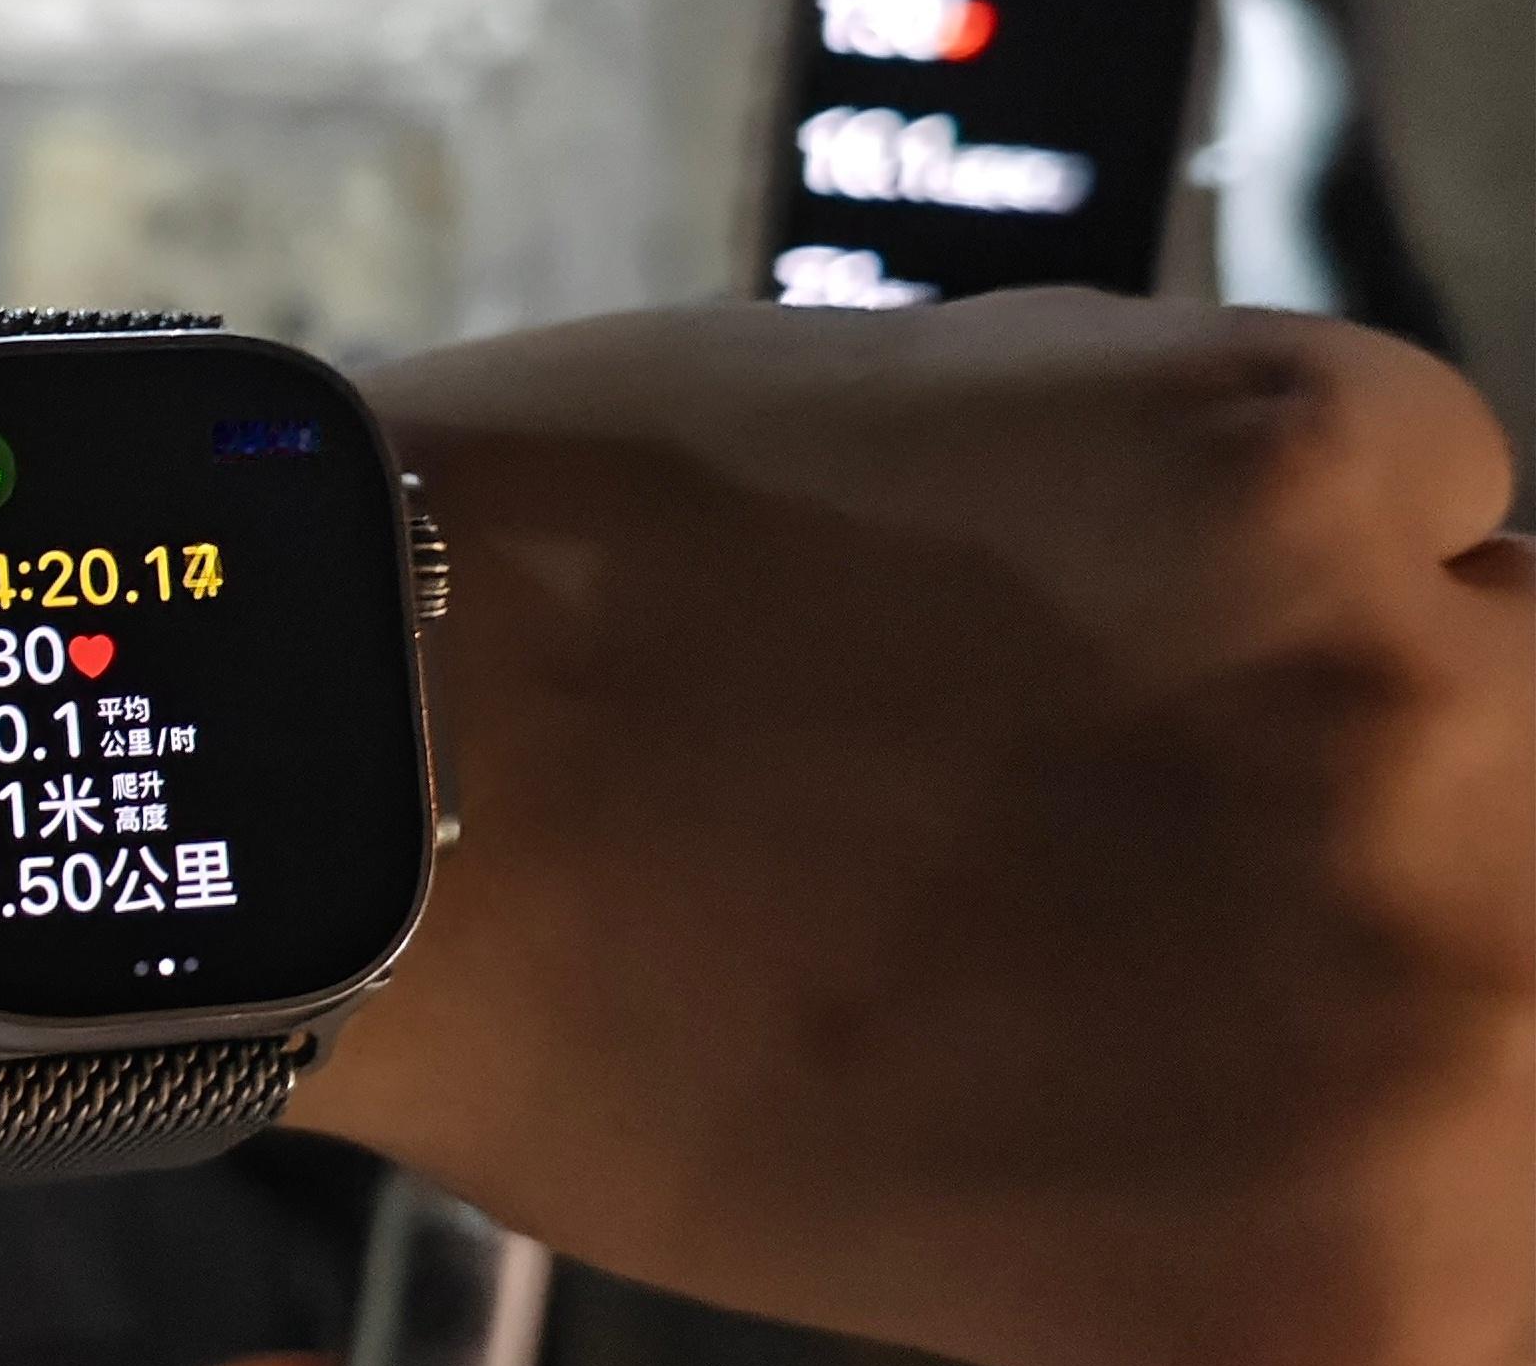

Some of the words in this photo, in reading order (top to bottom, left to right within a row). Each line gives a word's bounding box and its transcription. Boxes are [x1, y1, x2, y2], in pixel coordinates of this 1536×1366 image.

[97, 694, 151, 726] 平均
[100, 724, 197, 758] 公里/时
[112, 770, 165, 801] 爬升
[113, 802, 169, 834] 高度
